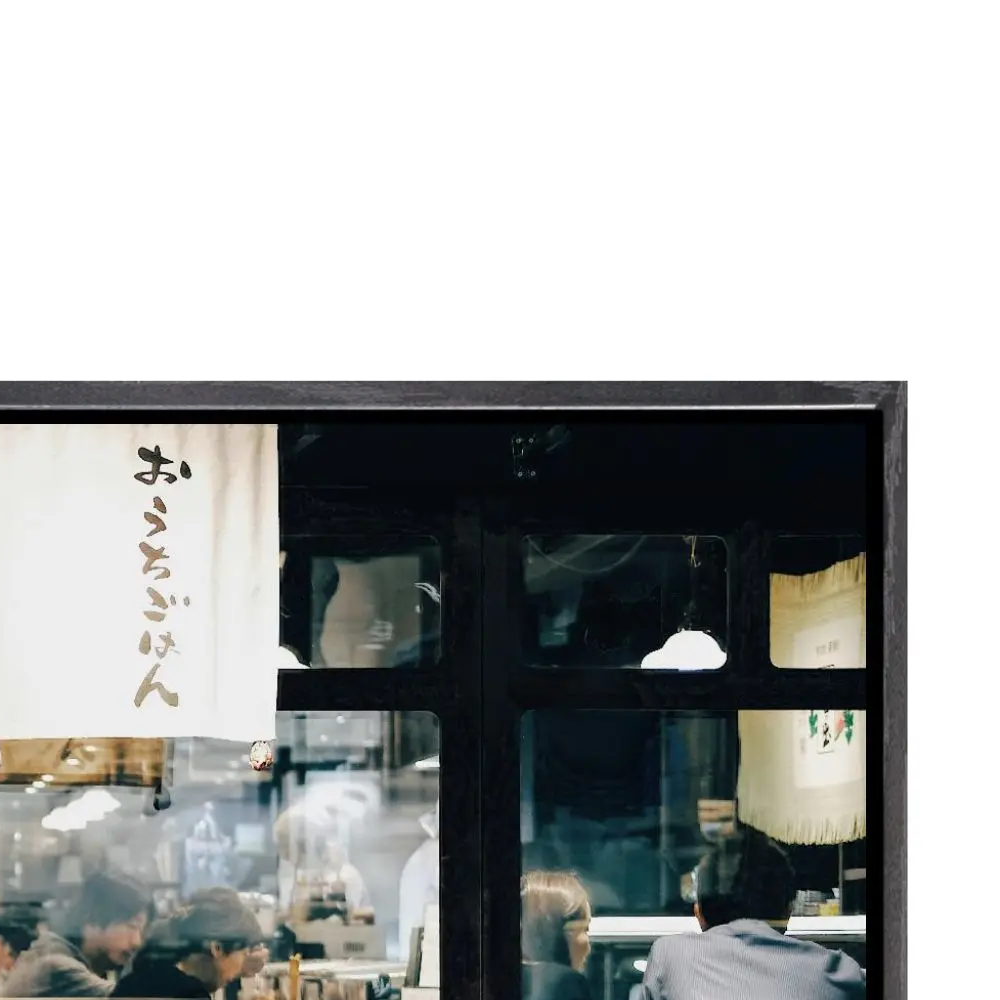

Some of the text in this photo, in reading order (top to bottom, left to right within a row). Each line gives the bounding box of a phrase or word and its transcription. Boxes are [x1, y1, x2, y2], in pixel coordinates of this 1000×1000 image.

[133, 445, 192, 708] おうちごはん
